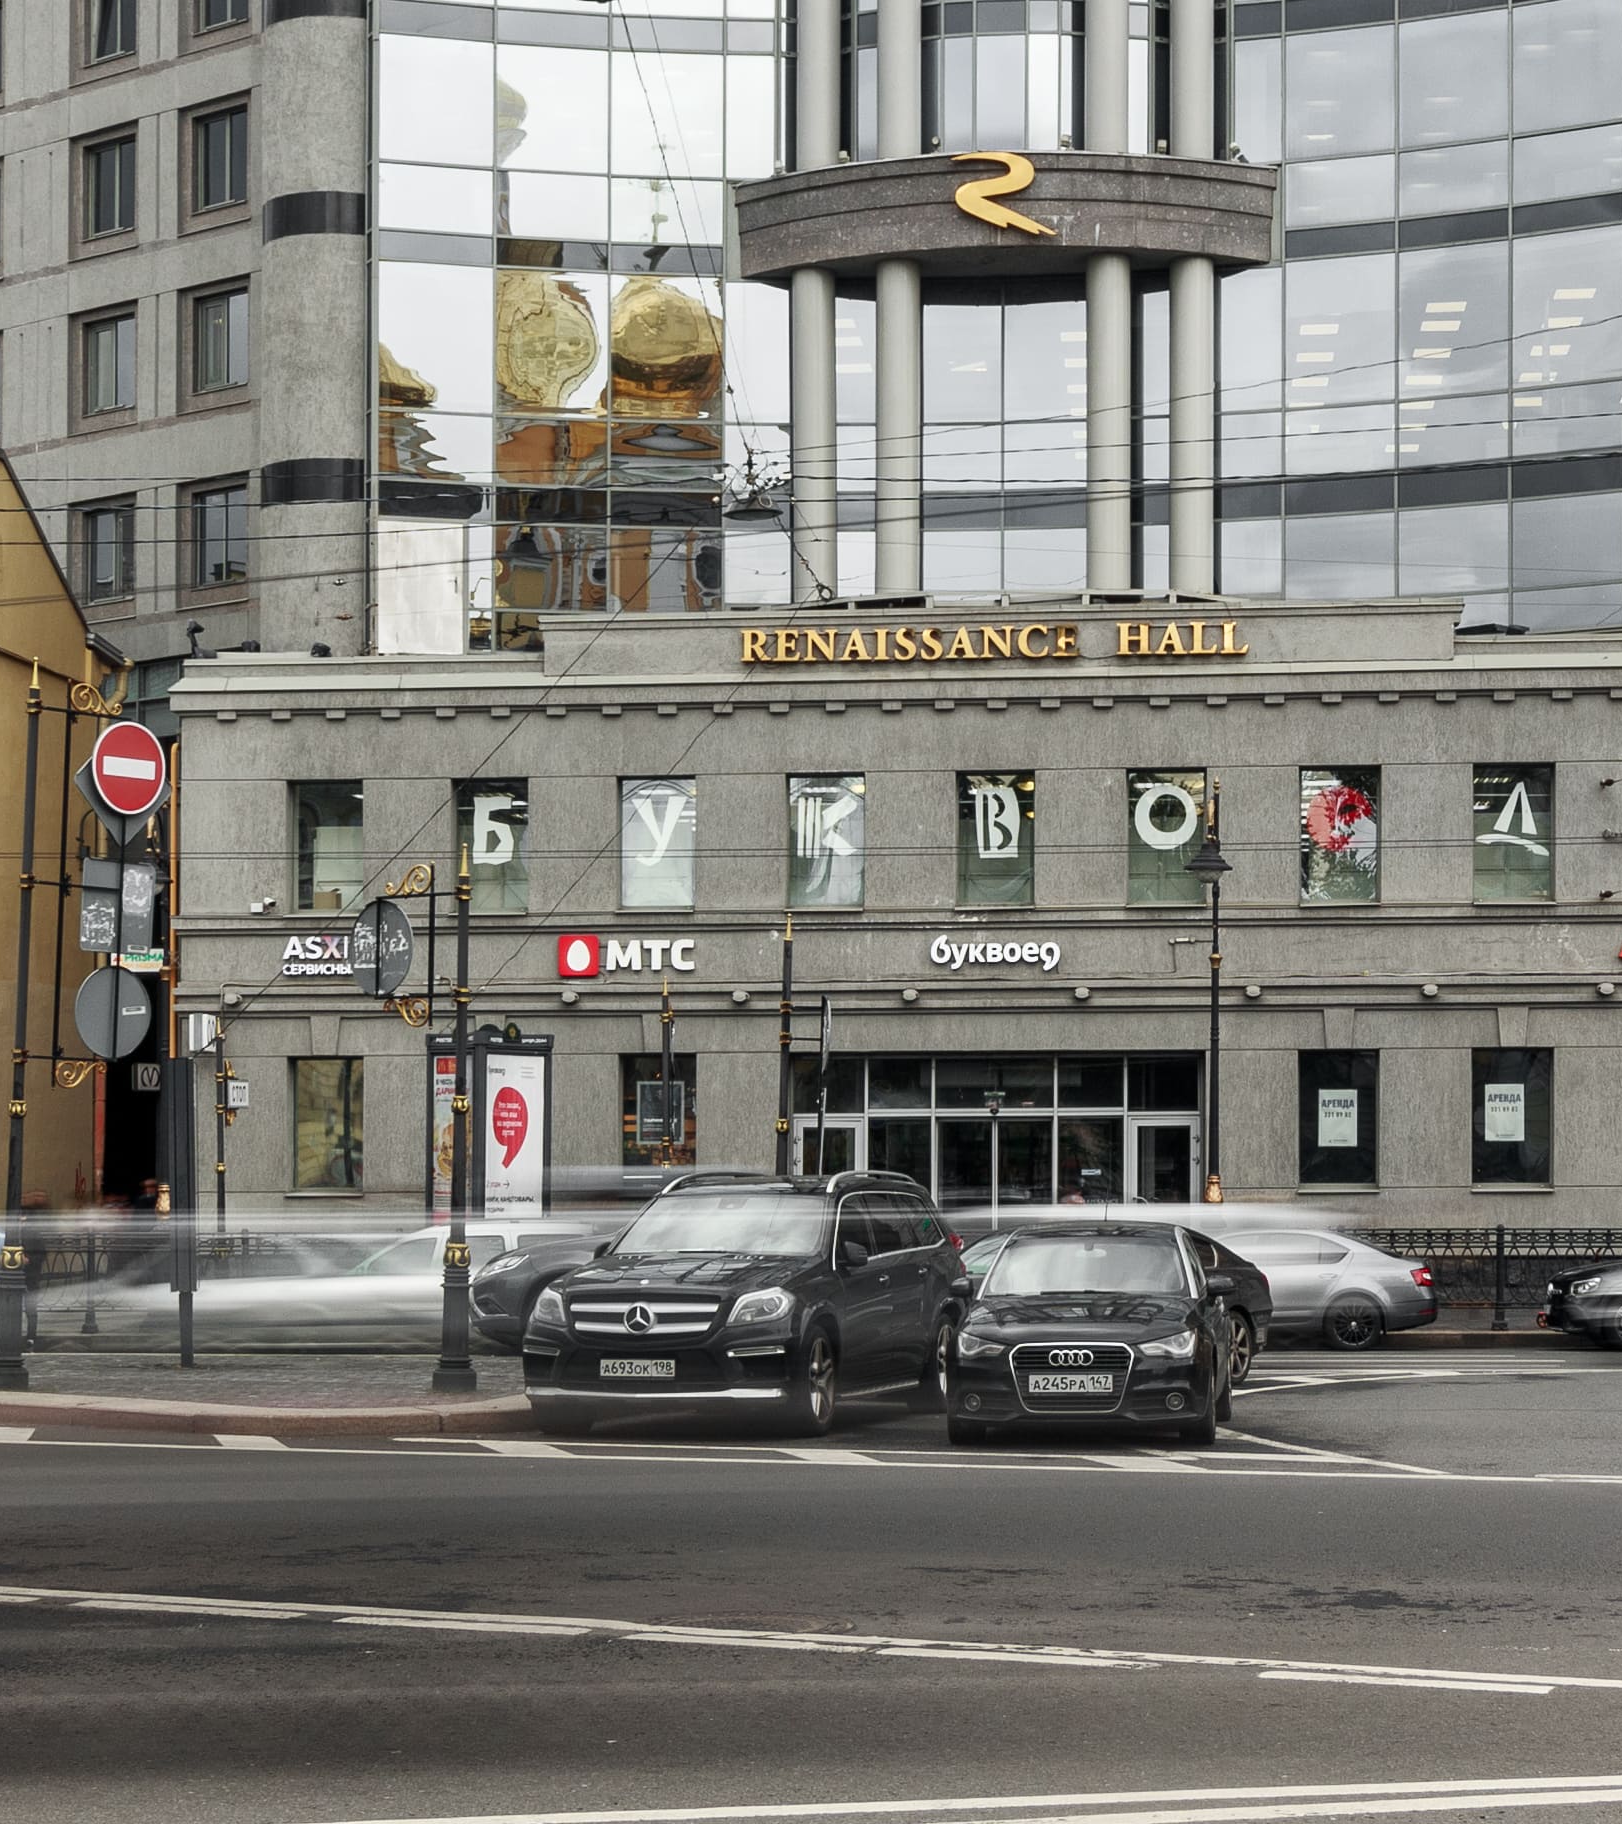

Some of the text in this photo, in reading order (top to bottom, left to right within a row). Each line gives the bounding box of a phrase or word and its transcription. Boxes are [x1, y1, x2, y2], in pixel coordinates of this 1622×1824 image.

[741, 621, 1250, 663] RENAISSANCE HALL
[605, 939, 695, 971] МТС
[282, 963, 354, 975] СЕРВИСНЫ
[1322, 1099, 1355, 1109] АРЕНДА
[1488, 1093, 1521, 1104] АРЕНДА
